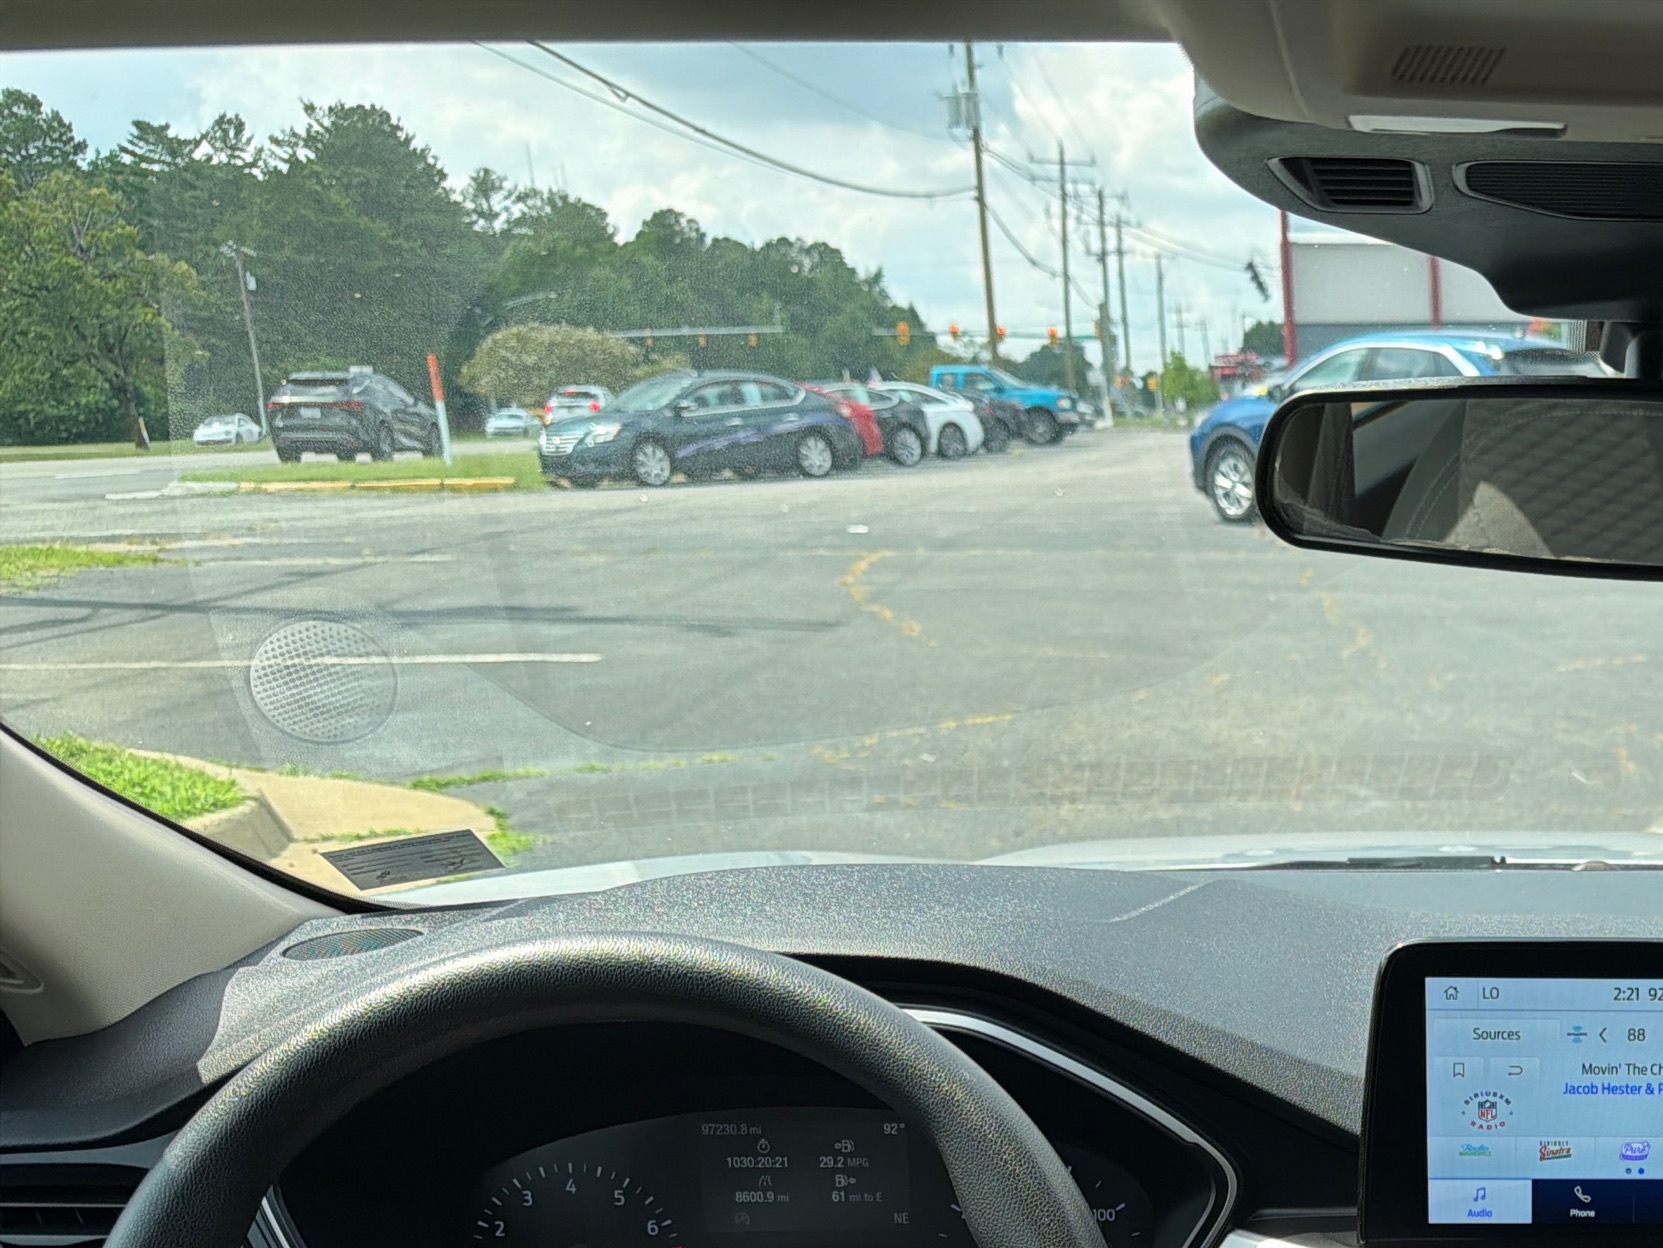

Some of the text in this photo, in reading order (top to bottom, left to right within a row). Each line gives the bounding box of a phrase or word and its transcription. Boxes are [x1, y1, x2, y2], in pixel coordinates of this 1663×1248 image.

[1481, 986, 1500, 1000] LO
[1613, 987, 1640, 1001] 2:21
[1472, 1027, 1521, 1041] Sources
[1627, 1028, 1646, 1042] 88
[1581, 1063, 1622, 1076] Movin'
[1625, 1063, 1648, 1076] The
[1562, 1082, 1599, 1096] Jacob
[1601, 1083, 1643, 1096] Hester
[1645, 1083, 1655, 1096] &
[1480, 1108, 1497, 1119] NFL
[701, 1124, 748, 1136] 97230.8
[883, 1123, 905, 1135] 92°
[1469, 1120, 1506, 1131] RADIO
[726, 1156, 789, 1169] 1030:20:21
[819, 1156, 870, 1168] 29.2 MPG
[565, 1179, 577, 1195] 4
[522, 1190, 533, 1206] 3
[614, 1189, 625, 1206] 5
[735, 1191, 790, 1203] 8600.9 mi
[831, 1191, 845, 1203] 61
[849, 1193, 862, 1203] mi
[864, 1193, 874, 1203] to
[893, 1213, 910, 1225] NE
[1092, 1209, 1116, 1222] 100
[1467, 1208, 1493, 1218] Audio
[1569, 1208, 1596, 1218] Phone
[494, 1221, 505, 1237] 2
[647, 1220, 659, 1236] 6
